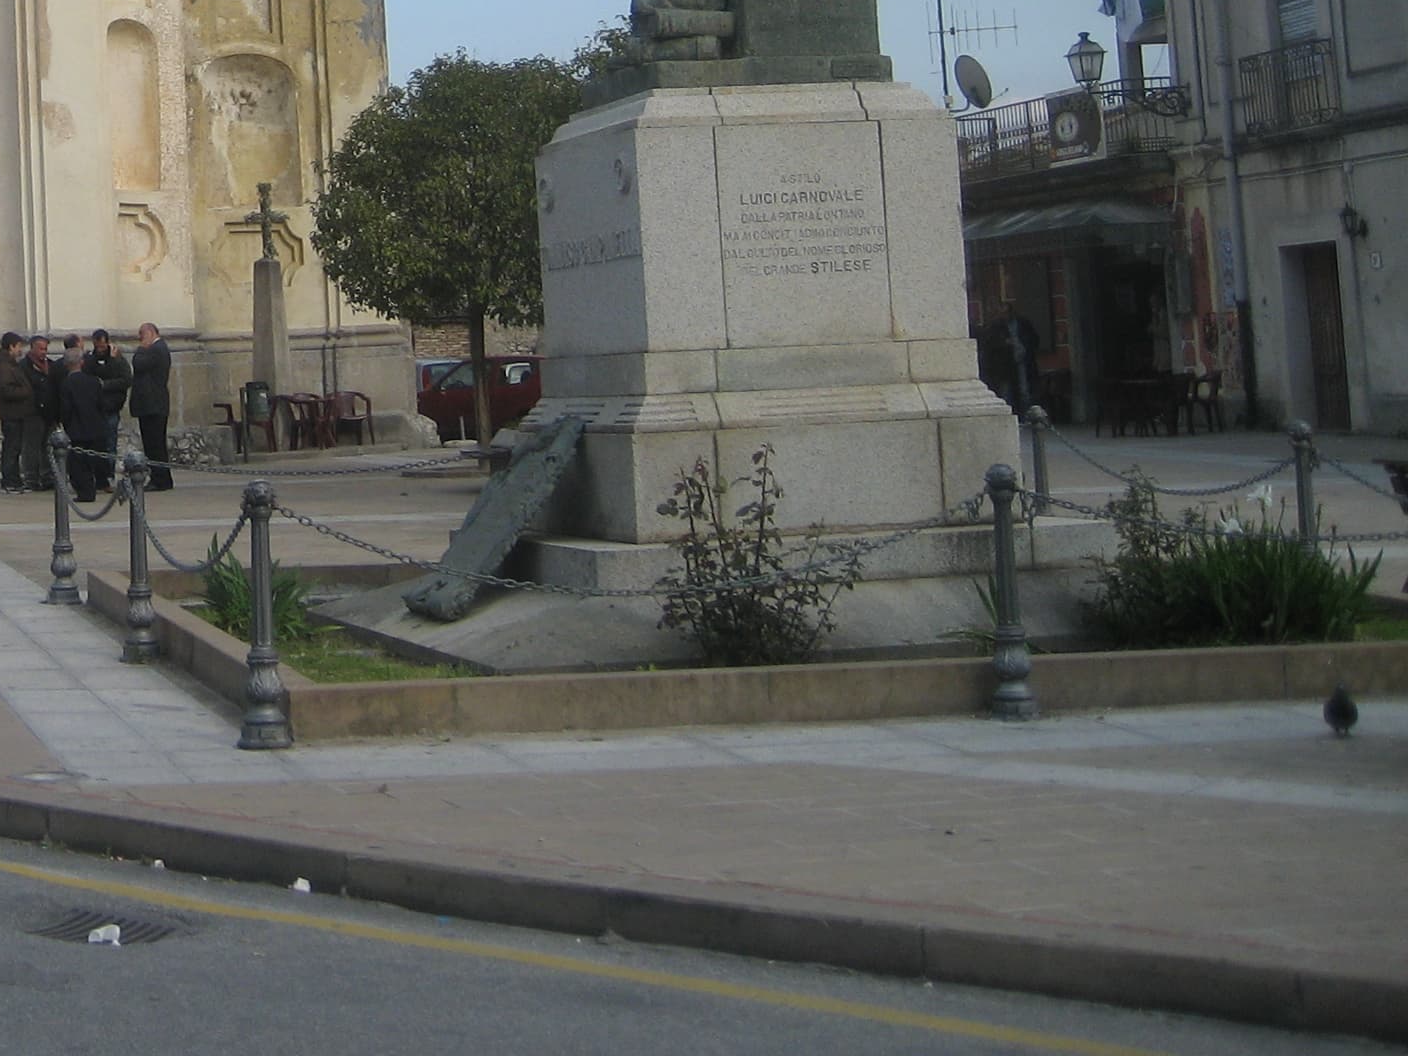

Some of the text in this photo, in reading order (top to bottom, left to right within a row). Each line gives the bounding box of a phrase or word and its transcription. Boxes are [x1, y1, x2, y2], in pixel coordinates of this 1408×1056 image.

[780, 189, 864, 205] CARNOVALE
[777, 210, 815, 223] PATRIA
[810, 258, 872, 275] STILESE
